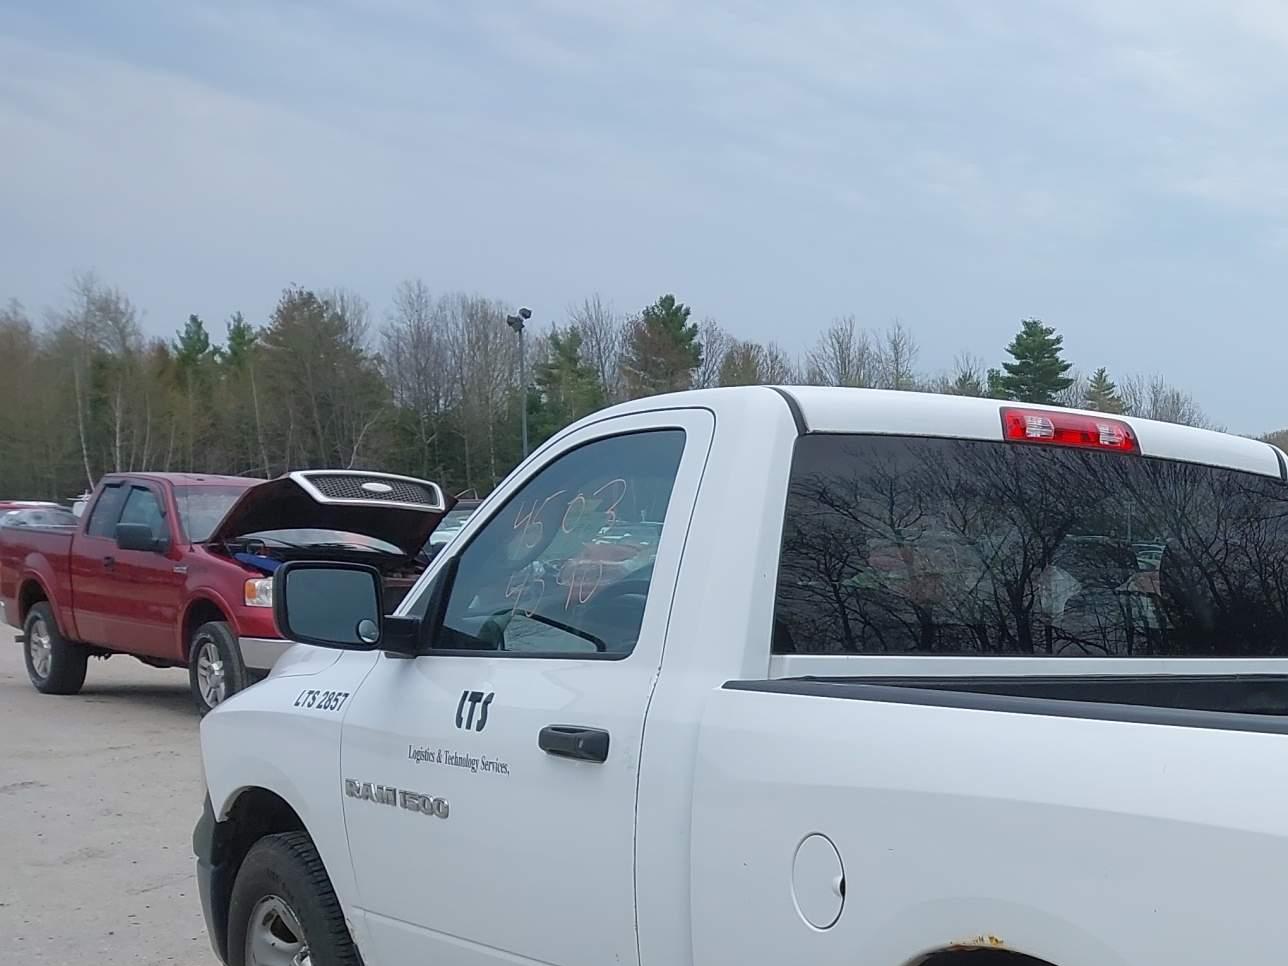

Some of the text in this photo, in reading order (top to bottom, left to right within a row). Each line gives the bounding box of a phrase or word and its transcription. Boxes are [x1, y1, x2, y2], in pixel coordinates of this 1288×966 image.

[294, 689, 350, 712] LTS 2857
[455, 690, 495, 732] LTS
[408, 744, 436, 764] Logistics
[436, 749, 443, 764] &
[443, 750, 480, 773] Technology
[345, 778, 449, 819] RAM 1500
